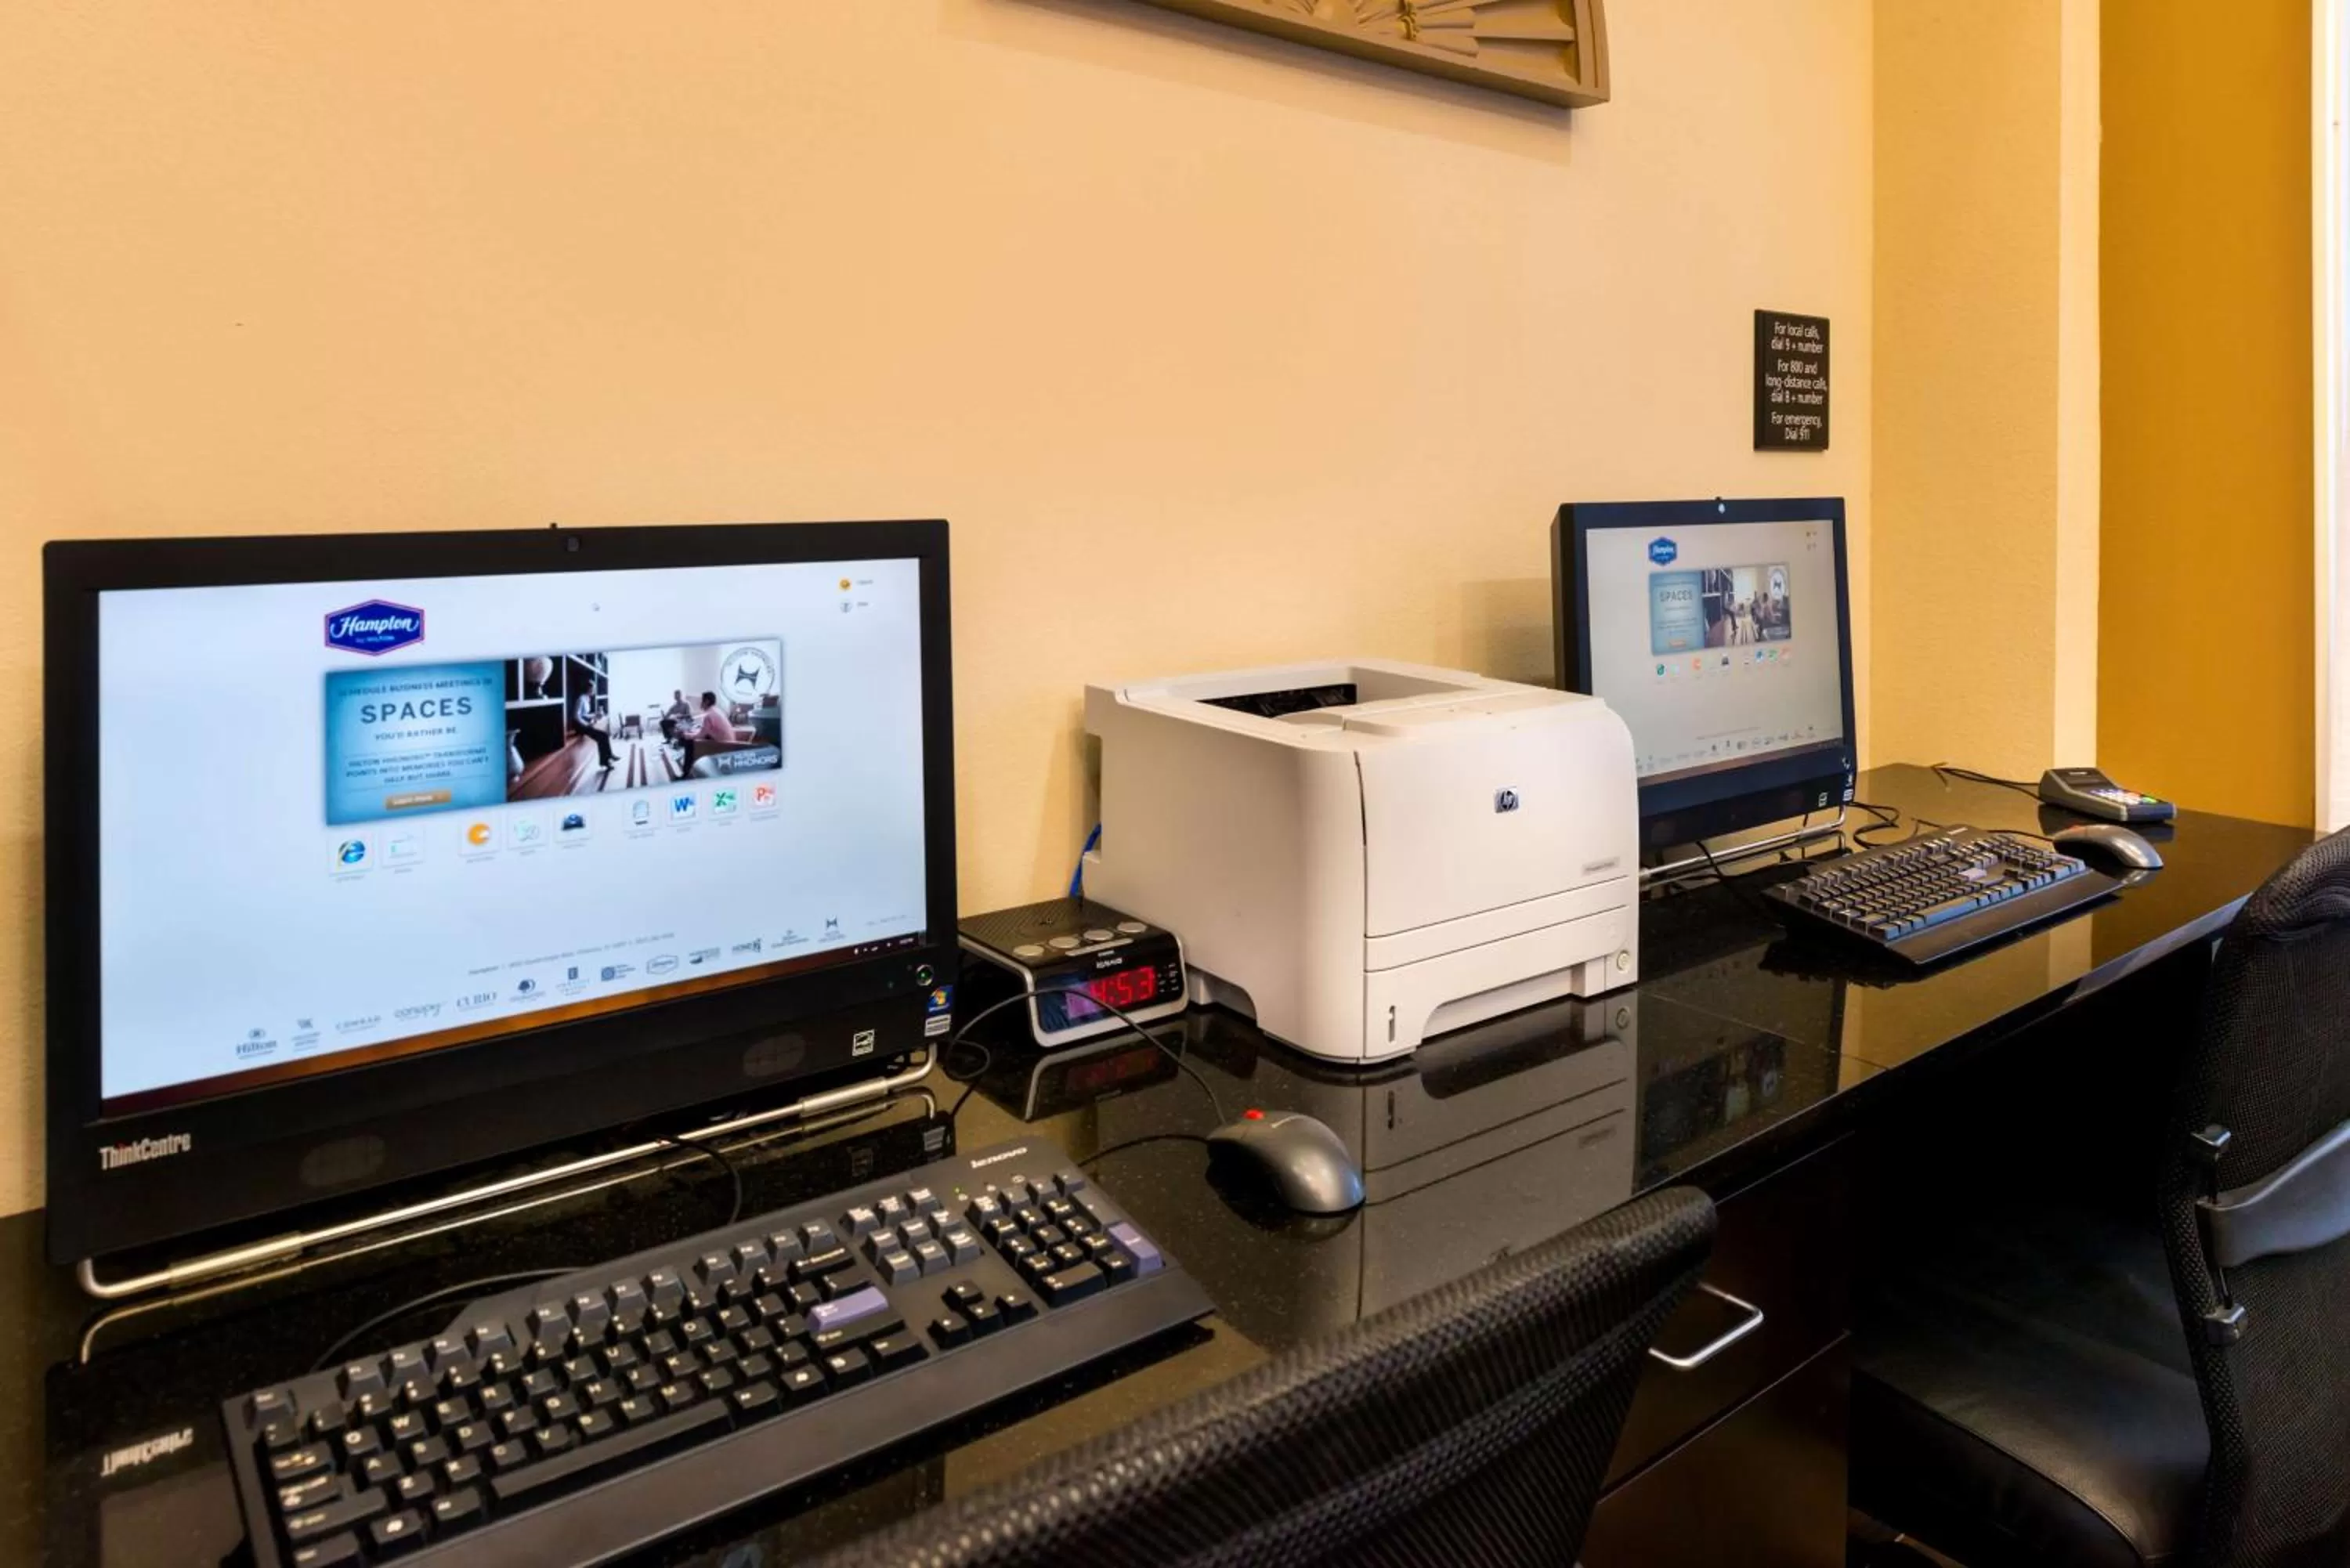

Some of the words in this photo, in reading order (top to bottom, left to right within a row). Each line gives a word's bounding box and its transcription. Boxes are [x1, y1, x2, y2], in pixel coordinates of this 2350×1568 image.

[1774, 322, 1786, 335] For
[1788, 323, 1802, 337] local
[1771, 337, 1784, 350] dial
[1798, 341, 1824, 353] number
[1777, 359, 1788, 373] For
[1790, 360, 1803, 374] 800
[1805, 362, 1817, 374] and
[1766, 373, 1811, 389] long-distance
[1771, 388, 1783, 403] dial
[1797, 392, 1823, 405] number
[1771, 411, 1784, 425] For
[1785, 427, 1798, 440] Dial
[330, 615, 419, 638] Hampton
[360, 696, 472, 724] SPACES
